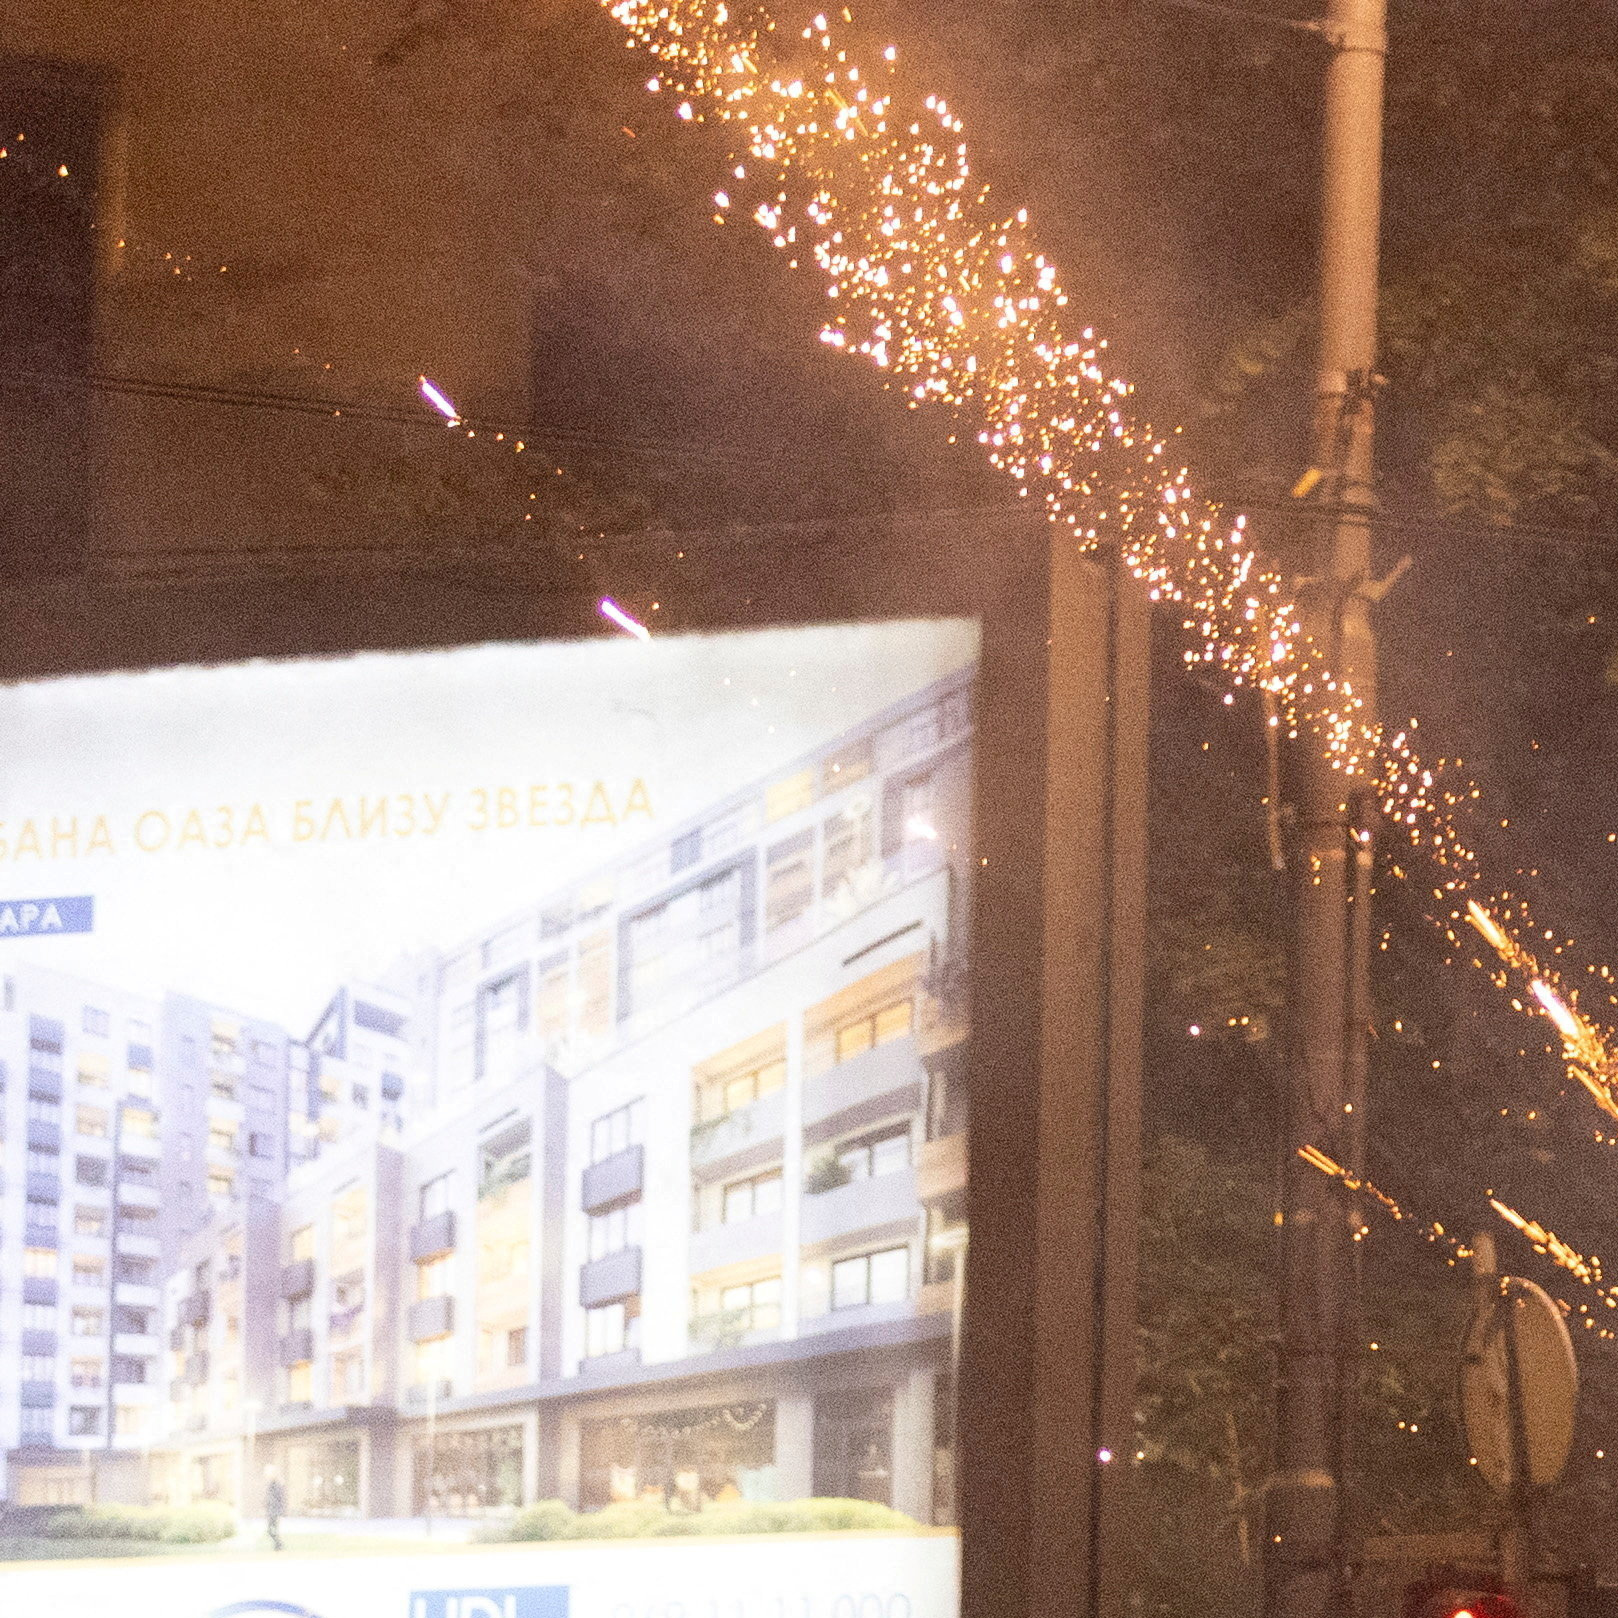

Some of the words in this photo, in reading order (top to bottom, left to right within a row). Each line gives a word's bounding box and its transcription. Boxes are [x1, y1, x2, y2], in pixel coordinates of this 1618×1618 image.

[134, 803, 272, 852] ОАЗА
[291, 791, 451, 844] БЛИЗУ
[468, 776, 655, 832] ЗВЕЗДА
